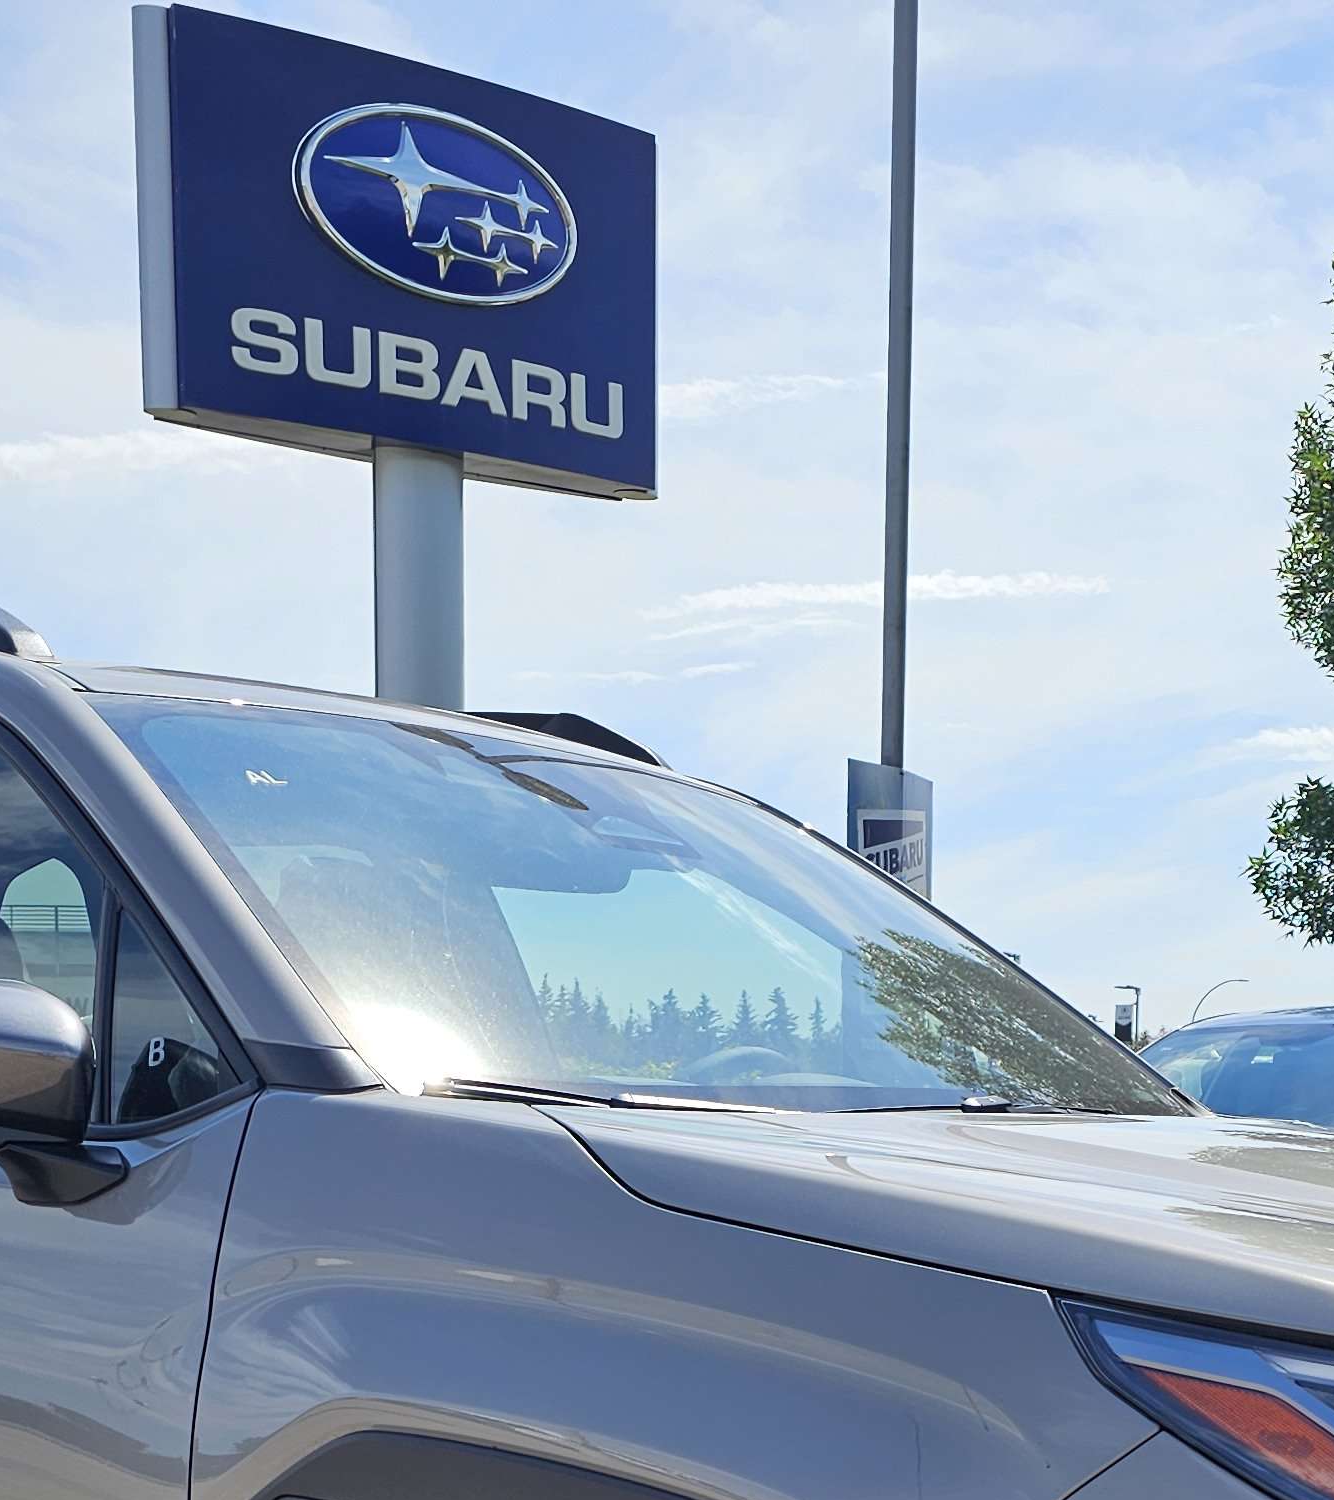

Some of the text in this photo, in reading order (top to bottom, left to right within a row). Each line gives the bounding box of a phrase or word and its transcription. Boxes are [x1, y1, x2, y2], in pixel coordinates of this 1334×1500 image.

[230, 306, 624, 440] SUBARU
[245, 769, 288, 785] AL
[148, 1036, 165, 1067] B
